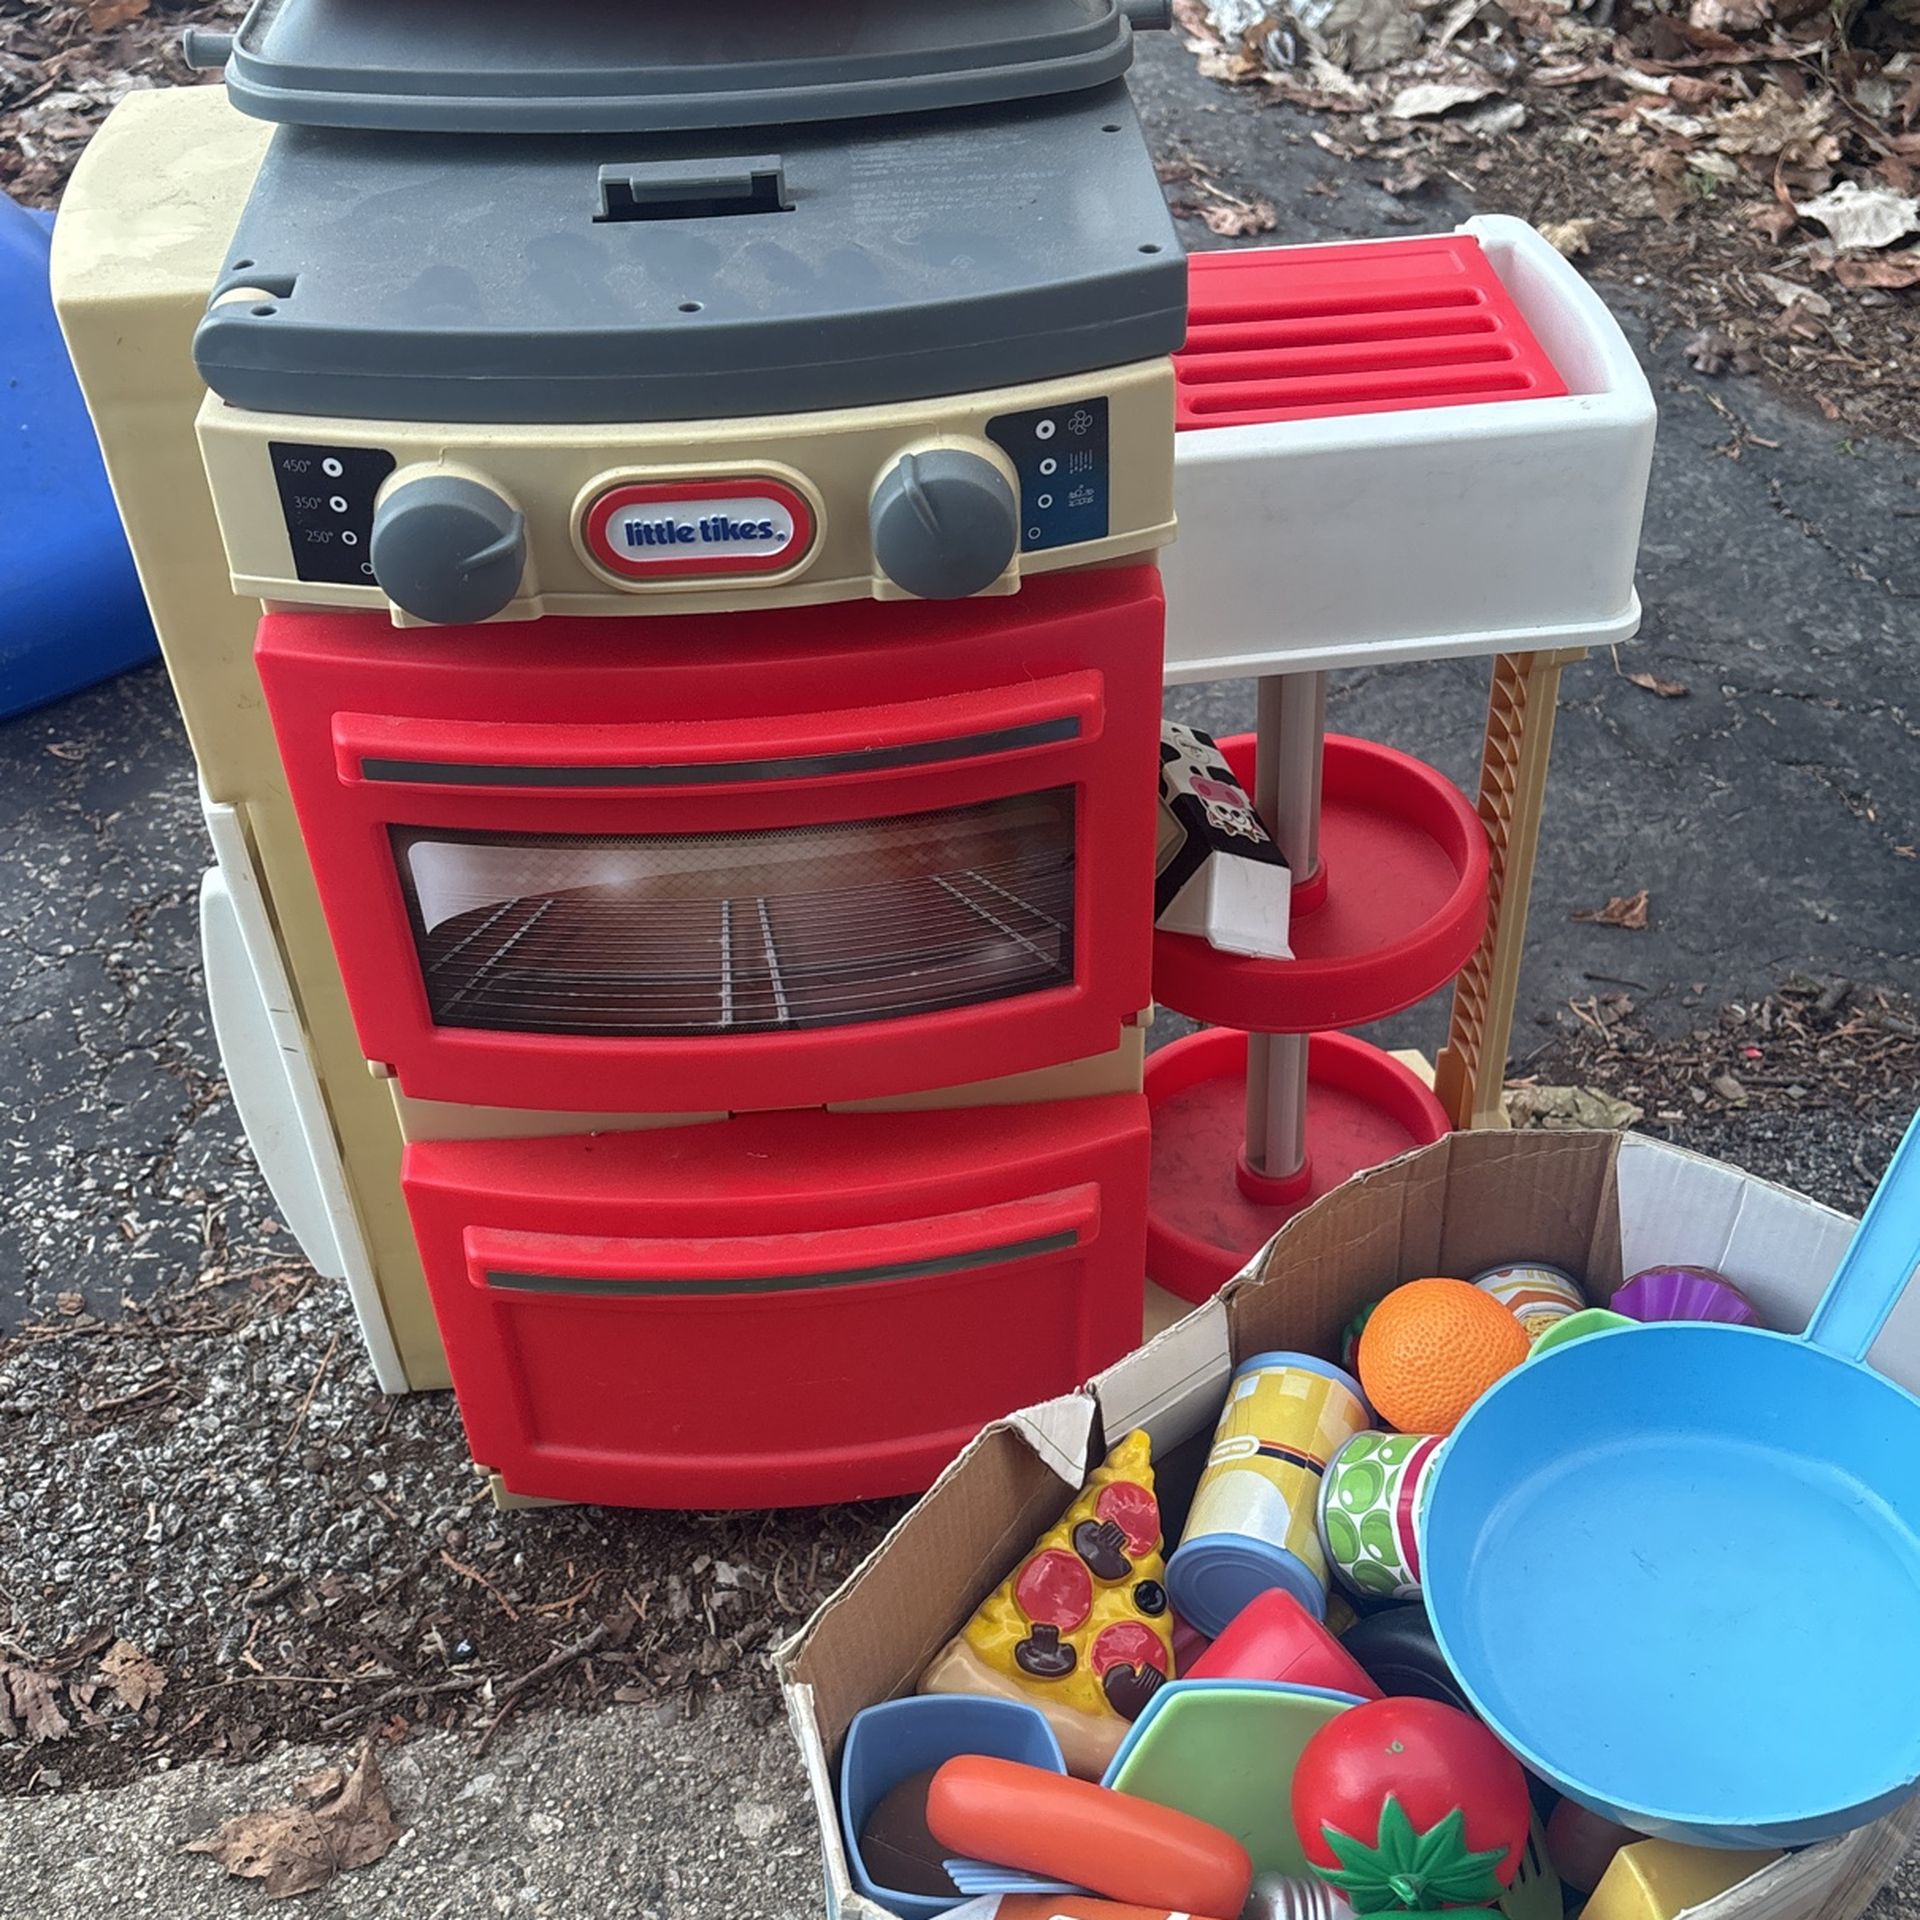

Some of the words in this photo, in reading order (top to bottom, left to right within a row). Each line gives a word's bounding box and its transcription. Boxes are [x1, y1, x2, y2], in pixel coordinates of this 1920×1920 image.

[283, 459, 312, 473] 450°
[294, 495, 322, 510] 350°
[305, 529, 334, 543] 250°
[624, 517, 696, 547] little
